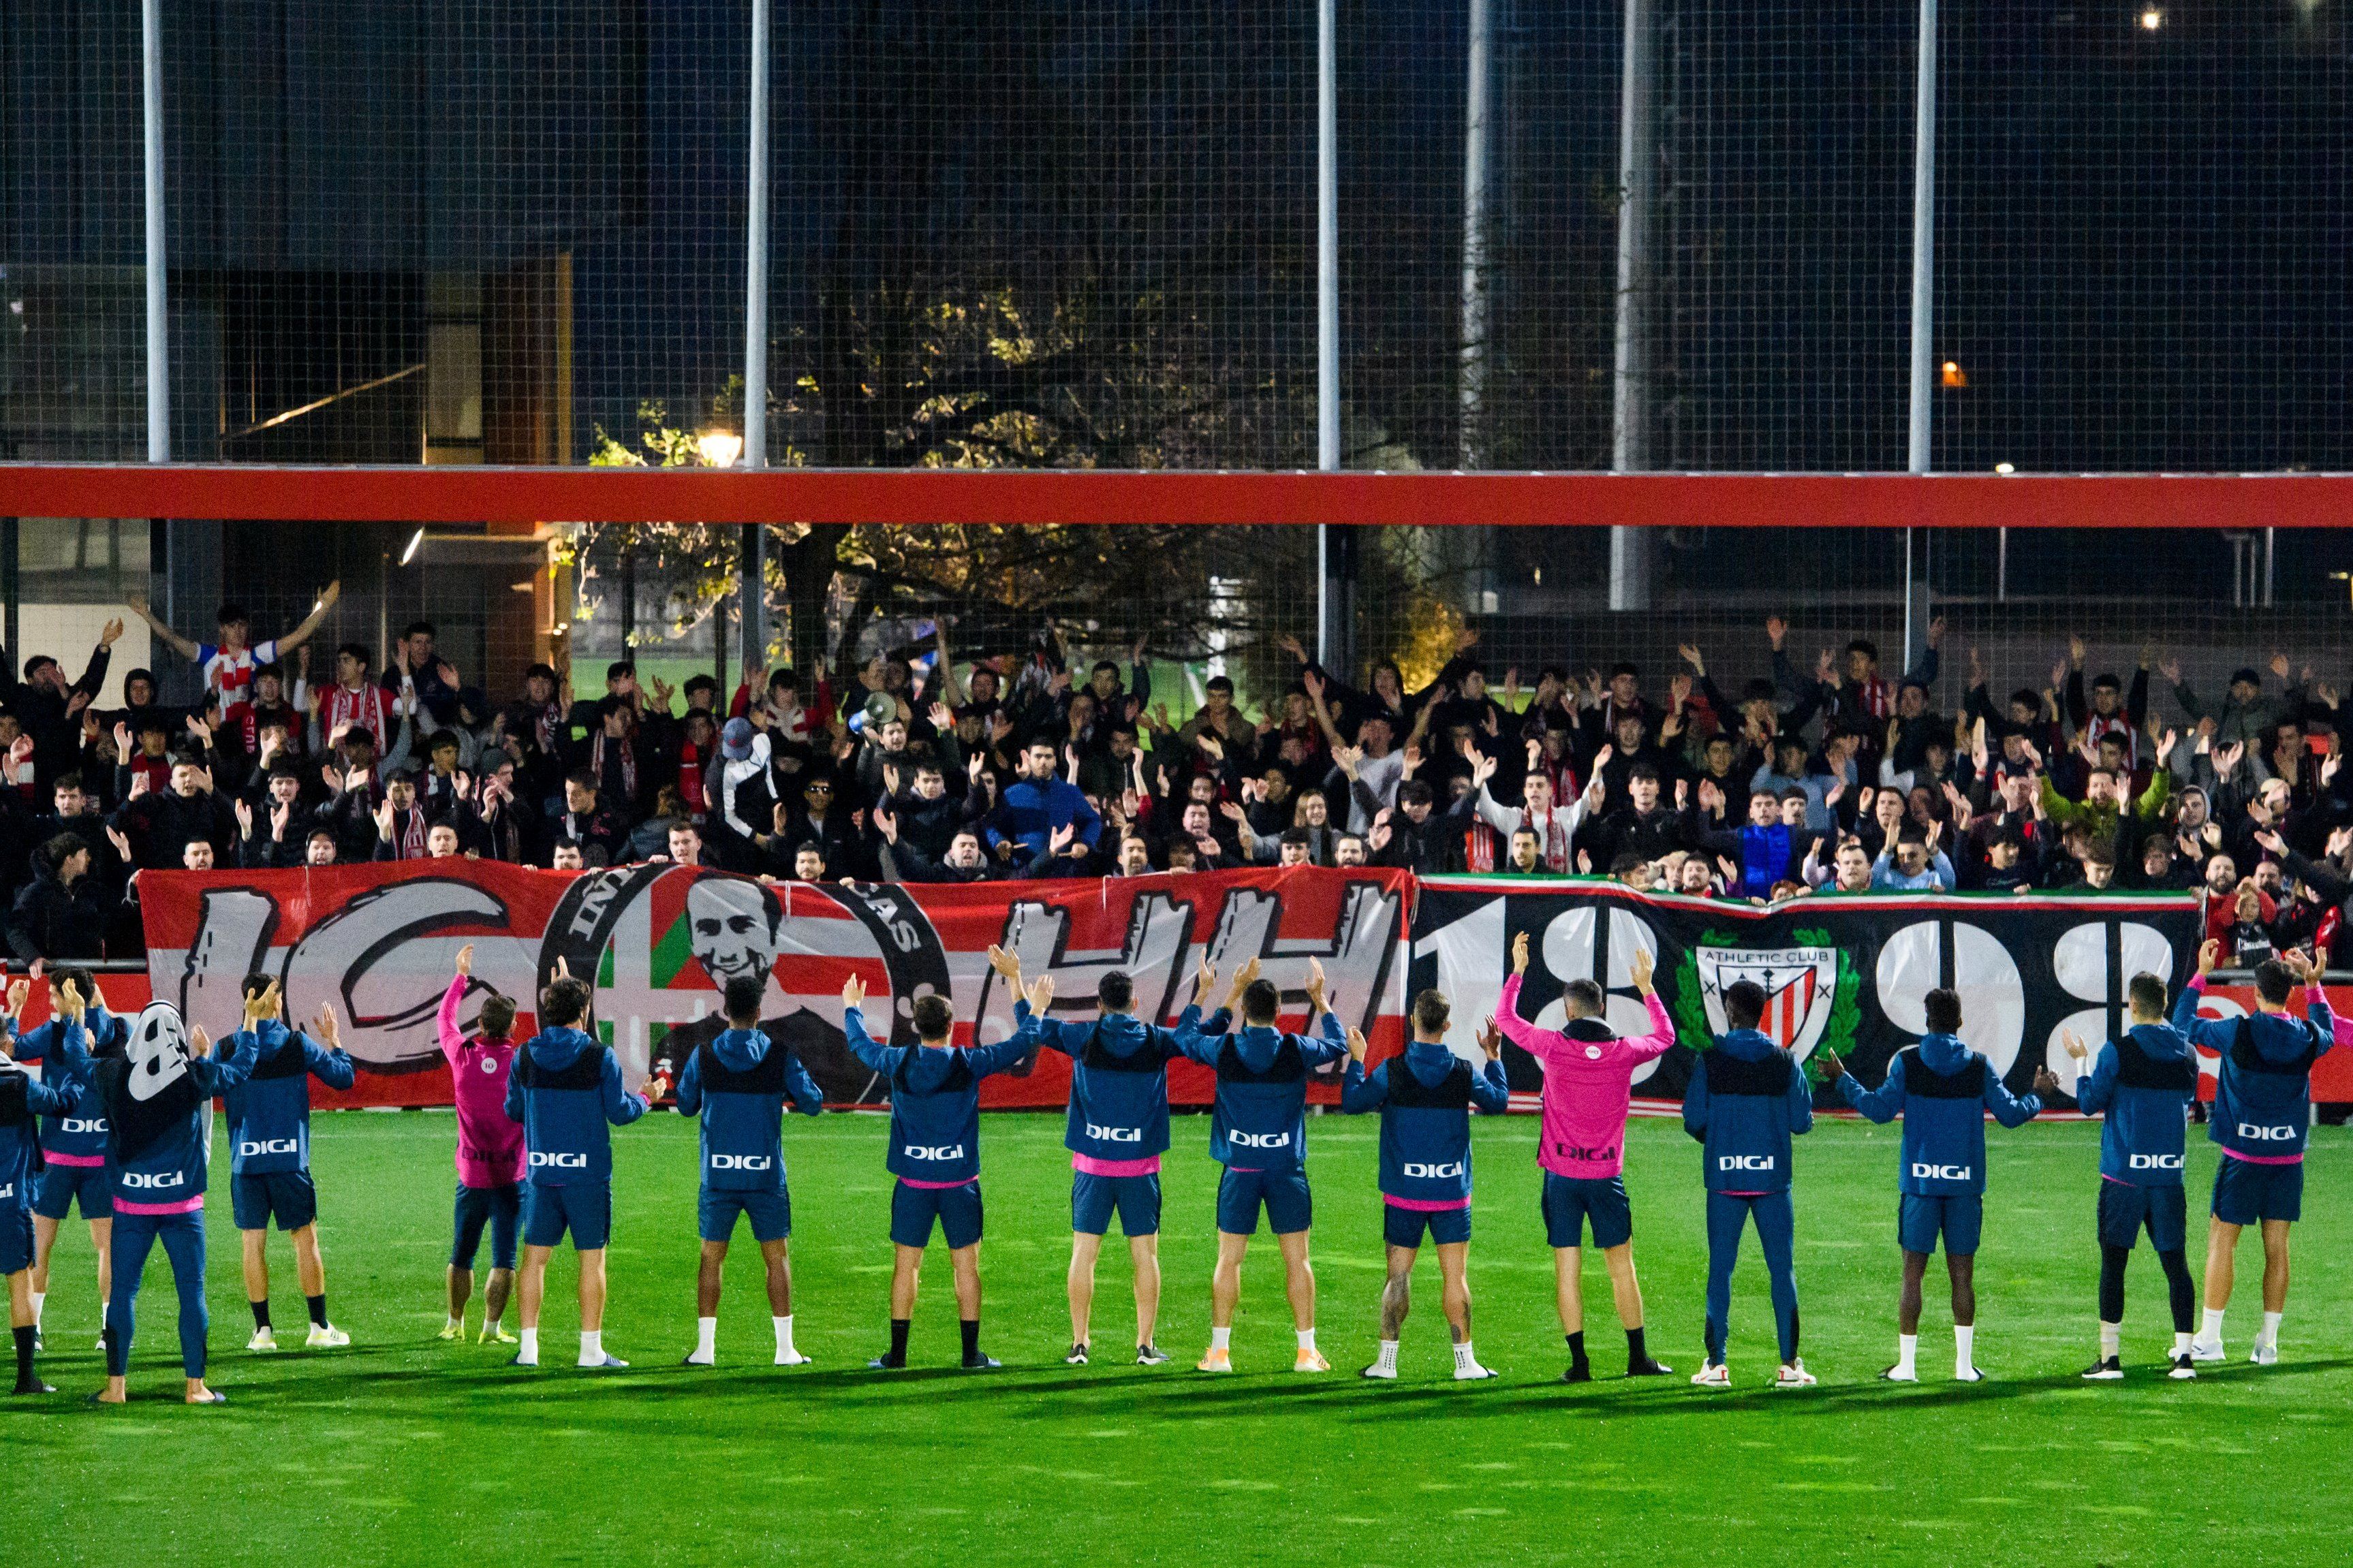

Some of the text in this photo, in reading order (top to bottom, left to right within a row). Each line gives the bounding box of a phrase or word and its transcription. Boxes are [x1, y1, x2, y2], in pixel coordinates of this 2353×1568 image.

[1705, 950, 1829, 963] ATHLETIC CLUB
[1086, 1123, 1141, 1142] DIGI
[1229, 1129, 1290, 1148] DIGI
[2238, 1123, 2296, 1140] DIGI
[240, 1138, 298, 1157] DIGI
[904, 1145, 964, 1161] DIGI
[1556, 1142, 1616, 1161] DIGI
[529, 1152, 587, 1167] DIGI
[711, 1154, 771, 1170] DIGI
[1719, 1155, 1774, 1171] DIGI
[2129, 1154, 2185, 1169] DIGI
[1403, 1161, 1463, 1178] DIGI
[1912, 1163, 1970, 1180] DIGI
[122, 1170, 184, 1189] DIGI
